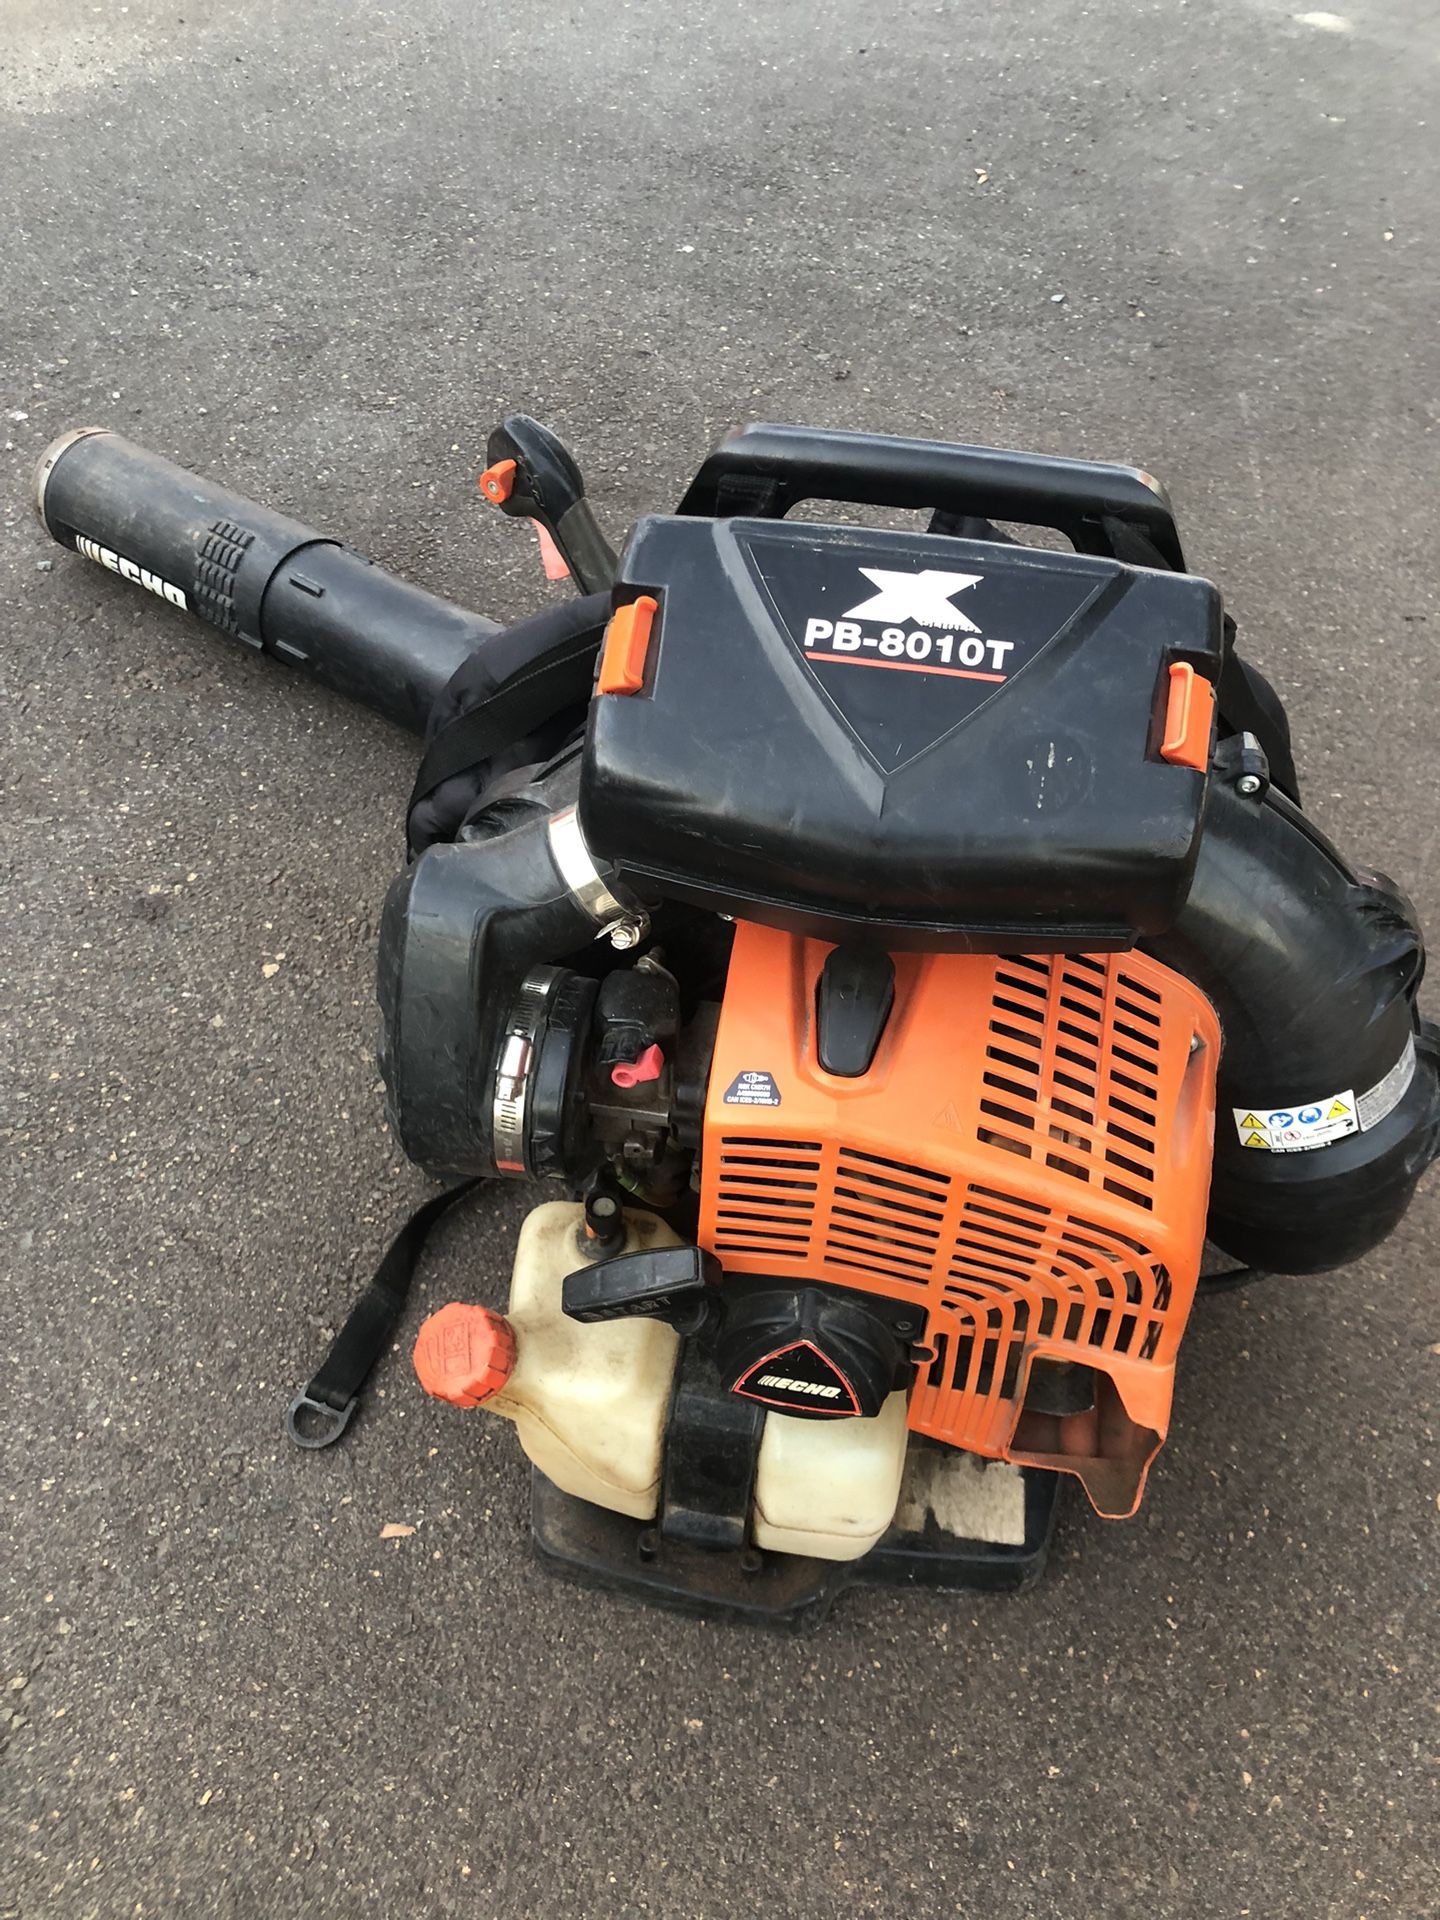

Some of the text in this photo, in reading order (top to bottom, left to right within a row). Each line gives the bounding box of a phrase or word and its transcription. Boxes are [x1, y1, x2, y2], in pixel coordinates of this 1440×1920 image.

[99, 547, 189, 611] ECHO
[804, 618, 1015, 670] PB-8010T
[775, 1378, 842, 1399] ECHO
